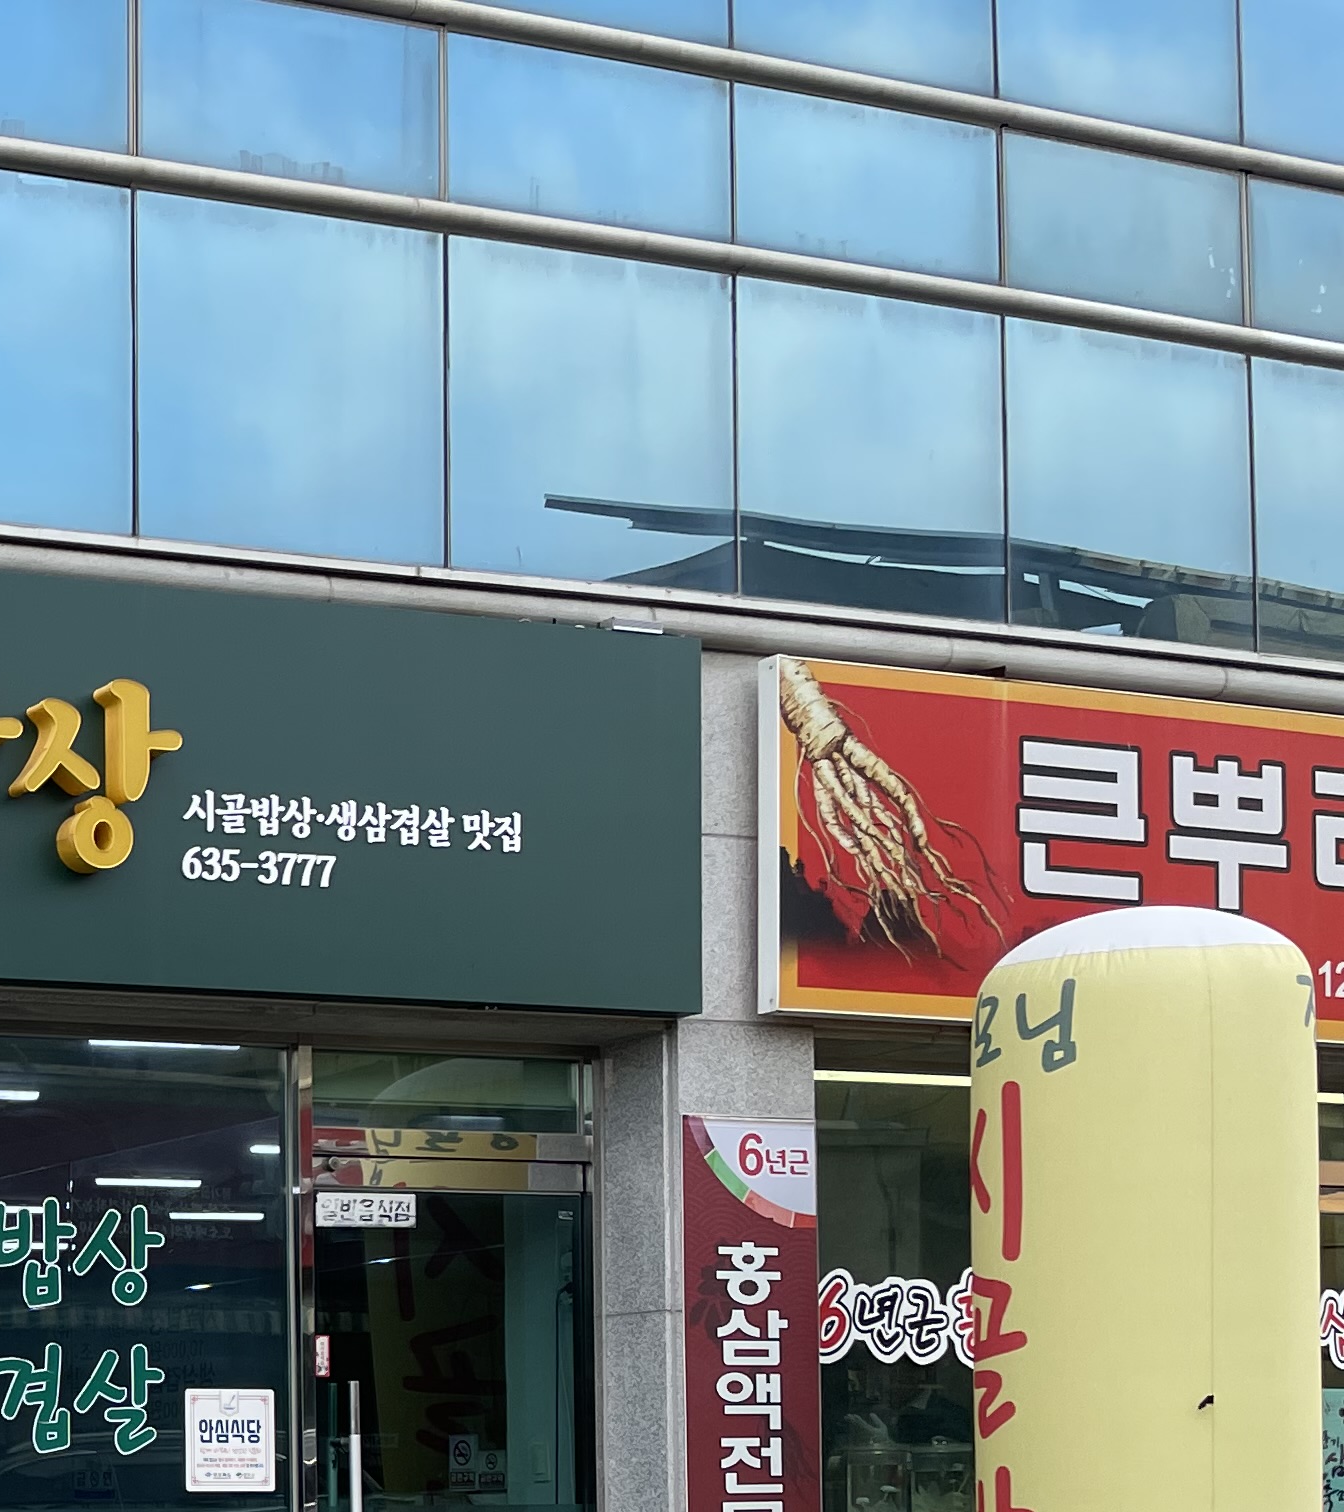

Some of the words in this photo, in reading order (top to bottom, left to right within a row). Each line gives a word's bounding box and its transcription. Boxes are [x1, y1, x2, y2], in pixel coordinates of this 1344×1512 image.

[462, 809, 523, 854] 맛집
[181, 846, 337, 888] 635-3777
[738, 1132, 810, 1177] 6년근
[198, 1418, 262, 1444] 안심식당
